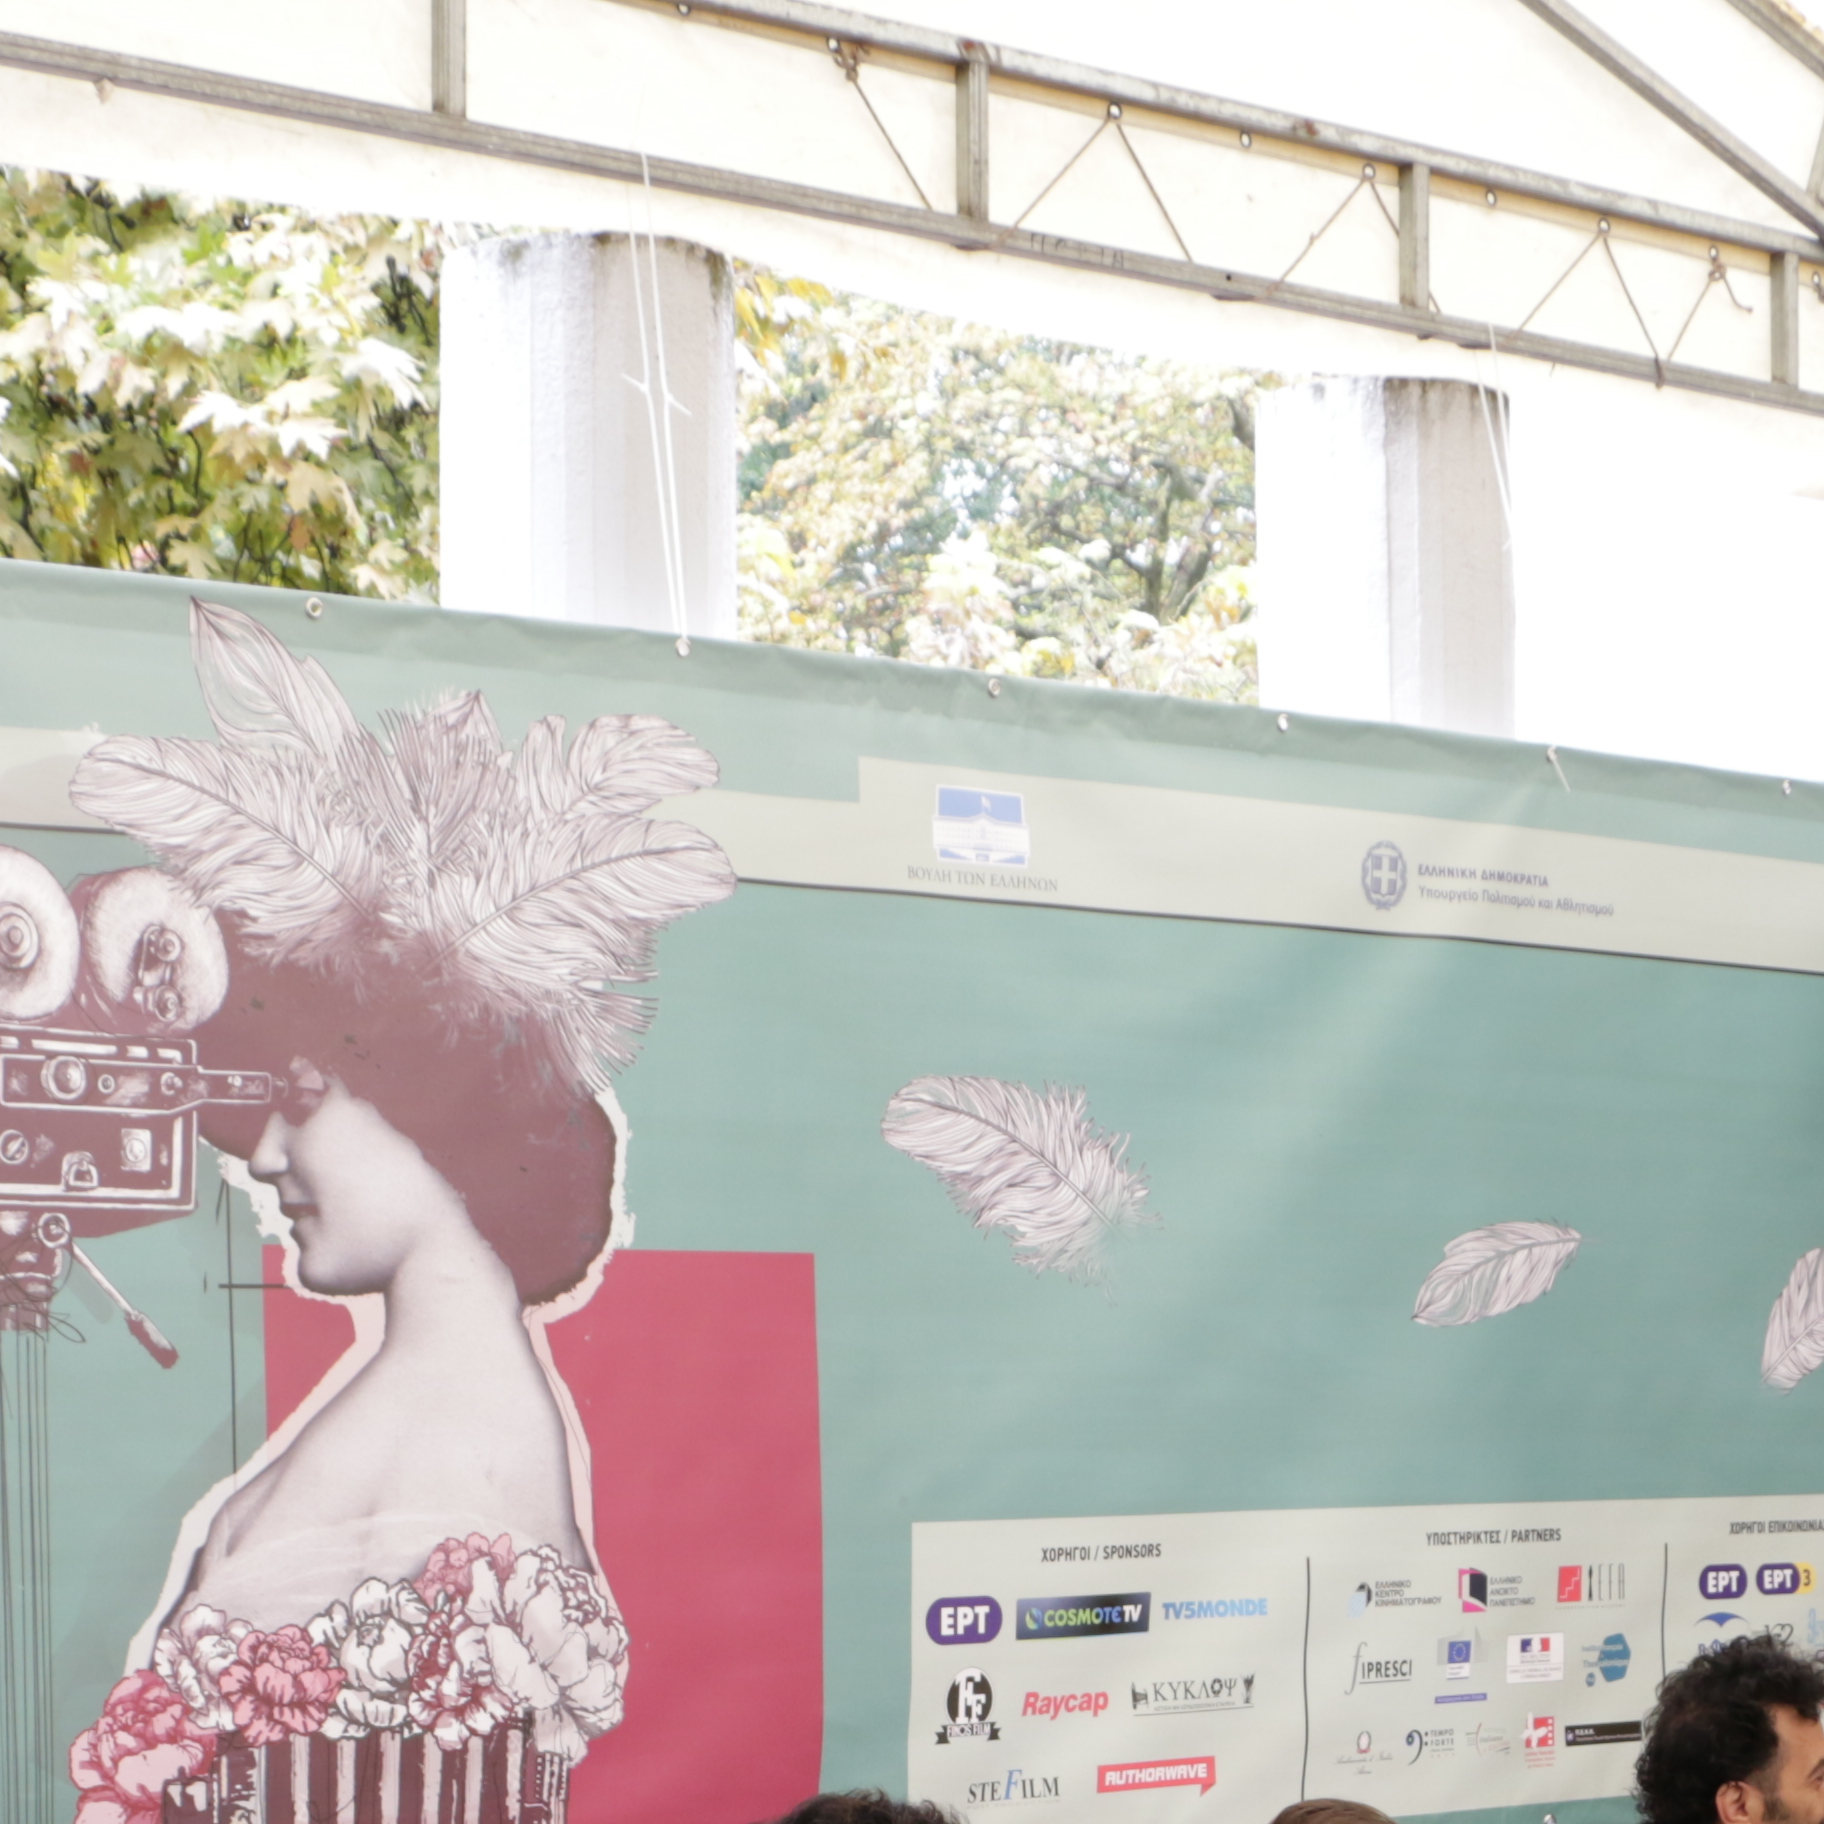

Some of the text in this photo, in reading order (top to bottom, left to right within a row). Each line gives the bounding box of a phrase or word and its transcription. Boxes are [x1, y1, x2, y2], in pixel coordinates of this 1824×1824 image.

[907, 865, 1058, 893] ΒΟΥΛΗ ΤΩΝ ΕΛΛΗΝΩΝ
[1418, 864, 1549, 887] ΕΛΛΗΝΙΚΗ ΔΗΜΟΚΡΑΤΙΑ
[1419, 885, 1614, 917] Υπουργείο Πολιτισμού και Αθλητισμού
[1426, 1530, 1501, 1546] ΥΠΟΣΤΗΡΙΚΤΕΣ
[1511, 1528, 1562, 1543] PARTNERS
[1729, 1521, 1766, 1535] ΧΟΡΗΓΟΙ
[1041, 1547, 1091, 1562] ΧΟΡΗΓΟΙ
[1102, 1544, 1162, 1560] SPONSORS
[1707, 1572, 1740, 1593] ΕΡΤ
[1763, 1569, 1812, 1589] ΕΡΤ 3
[1162, 1597, 1268, 1620] TV5MONDE
[940, 1605, 990, 1636] ΕΡΤ
[1152, 1677, 1237, 1702] ΚΥΚΛΟΨ
[1021, 1691, 1109, 1720] Raycap
[1104, 1763, 1208, 1787] AUTHORWAVE
